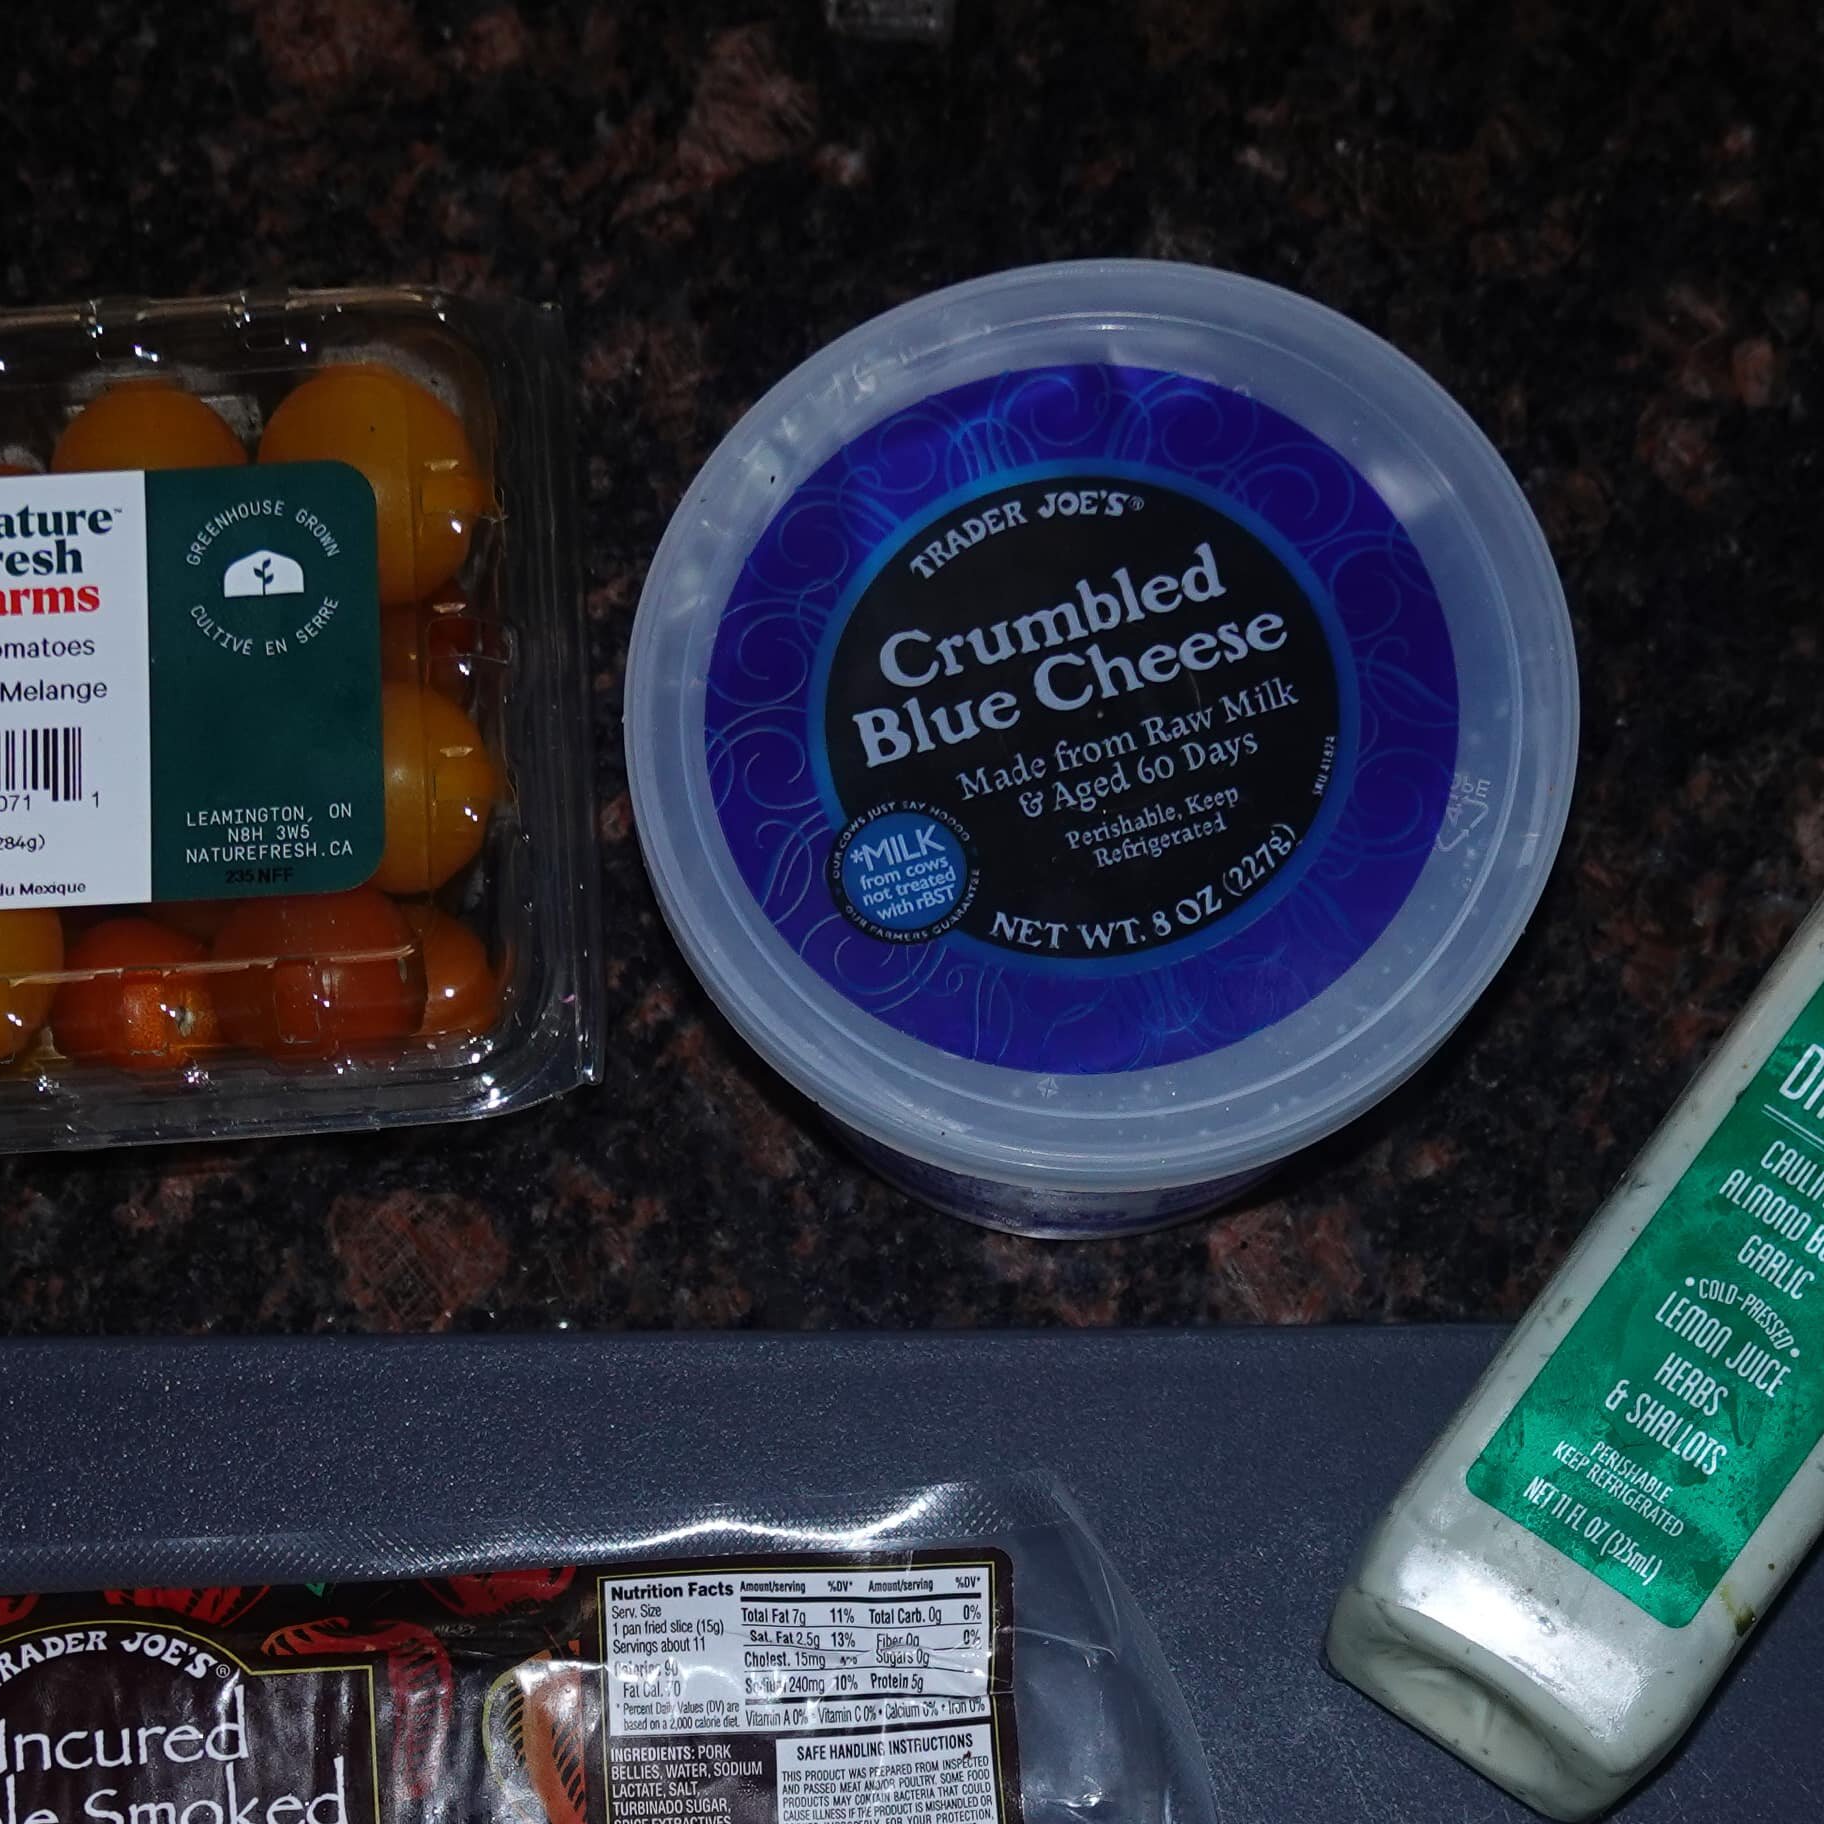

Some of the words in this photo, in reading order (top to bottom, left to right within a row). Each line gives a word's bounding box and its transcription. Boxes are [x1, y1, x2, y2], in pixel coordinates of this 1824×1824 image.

[186, 500, 285, 566] GREENHOUSE
[295, 508, 341, 558] GROWN
[908, 500, 1028, 583] TRADER
[265, 638, 288, 656] EN
[296, 596, 339, 644] SERRE
[878, 542, 1228, 688] Crumbled
[0, 679, 107, 703] Melange
[851, 688, 1021, 769] Blue
[1032, 609, 1288, 712] Cheese
[956, 753, 1047, 801] Made
[1055, 730, 1137, 772] from
[1140, 706, 1214, 747] Raw
[1219, 676, 1300, 724] Milk
[91, 791, 100, 807] 1
[1018, 791, 1044, 818] &
[1052, 762, 1131, 812] Aged
[1137, 754, 1175, 785] 60
[1179, 731, 1259, 772] Days
[186, 806, 313, 827] LEAMINGTON,
[329, 803, 352, 819] ON
[228, 827, 263, 843] N8H
[276, 824, 311, 840] 3W5
[1065, 805, 1183, 850] Perishable,
[1184, 786, 1240, 816] Keep
[1094, 811, 1227, 869] Refrigerated
[186, 840, 353, 864] NATUREFRESH.CA
[226, 868, 254, 884] 235
[257, 867, 294, 883] NFF
[860, 869, 901, 891] from
[906, 856, 948, 877] cows
[20, 882, 86, 896] Mexique
[863, 889, 893, 907] not
[895, 865, 956, 896] treated
[877, 898, 914, 920] with
[916, 884, 955, 910] rBST
[989, 911, 1068, 949] NET
[1077, 918, 1146, 950] WT.
[1152, 909, 1172, 937] 8
[1176, 884, 1223, 925] OZ
[1223, 823, 1297, 896] (227g)
[1719, 1168, 1808, 1243] ALMOND
[1736, 1235, 1816, 1301] GARLIC
[1654, 1290, 1733, 1359] LEMON
[1726, 1342, 1792, 1399] JUICE
[1698, 1277, 1795, 1350] COLD-PRESSED
[1652, 1352, 1728, 1417] HERBS
[1604, 1379, 1630, 1411] &
[1625, 1393, 1728, 1477] SHALLOTS
[1553, 1440, 1591, 1479] KEEP
[1586, 1462, 1685, 1538] REFRIGERATED
[1590, 1440, 1674, 1505] PERISHABLE
[1522, 1476, 1556, 1508] NET
[1554, 1495, 1569, 1521] 11
[1563, 1501, 1584, 1531] FL
[1584, 1516, 1606, 1545] OZ
[1599, 1526, 1663, 1586] (325mL)
[611, 1585, 684, 1601] Nutrition
[687, 1582, 733, 1597] Facts
[611, 1746, 696, 1762] INGREDIENTS:
[698, 1745, 732, 1758] PORK
[611, 1766, 663, 1780] BELLIES,
[666, 1763, 711, 1778] WATER,
[714, 1761, 763, 1776] SODIUM
[797, 1746, 827, 1760] SAFE
[830, 1742, 884, 1759] HANDLING
[889, 1733, 973, 1755] INSTRUCTIONS
